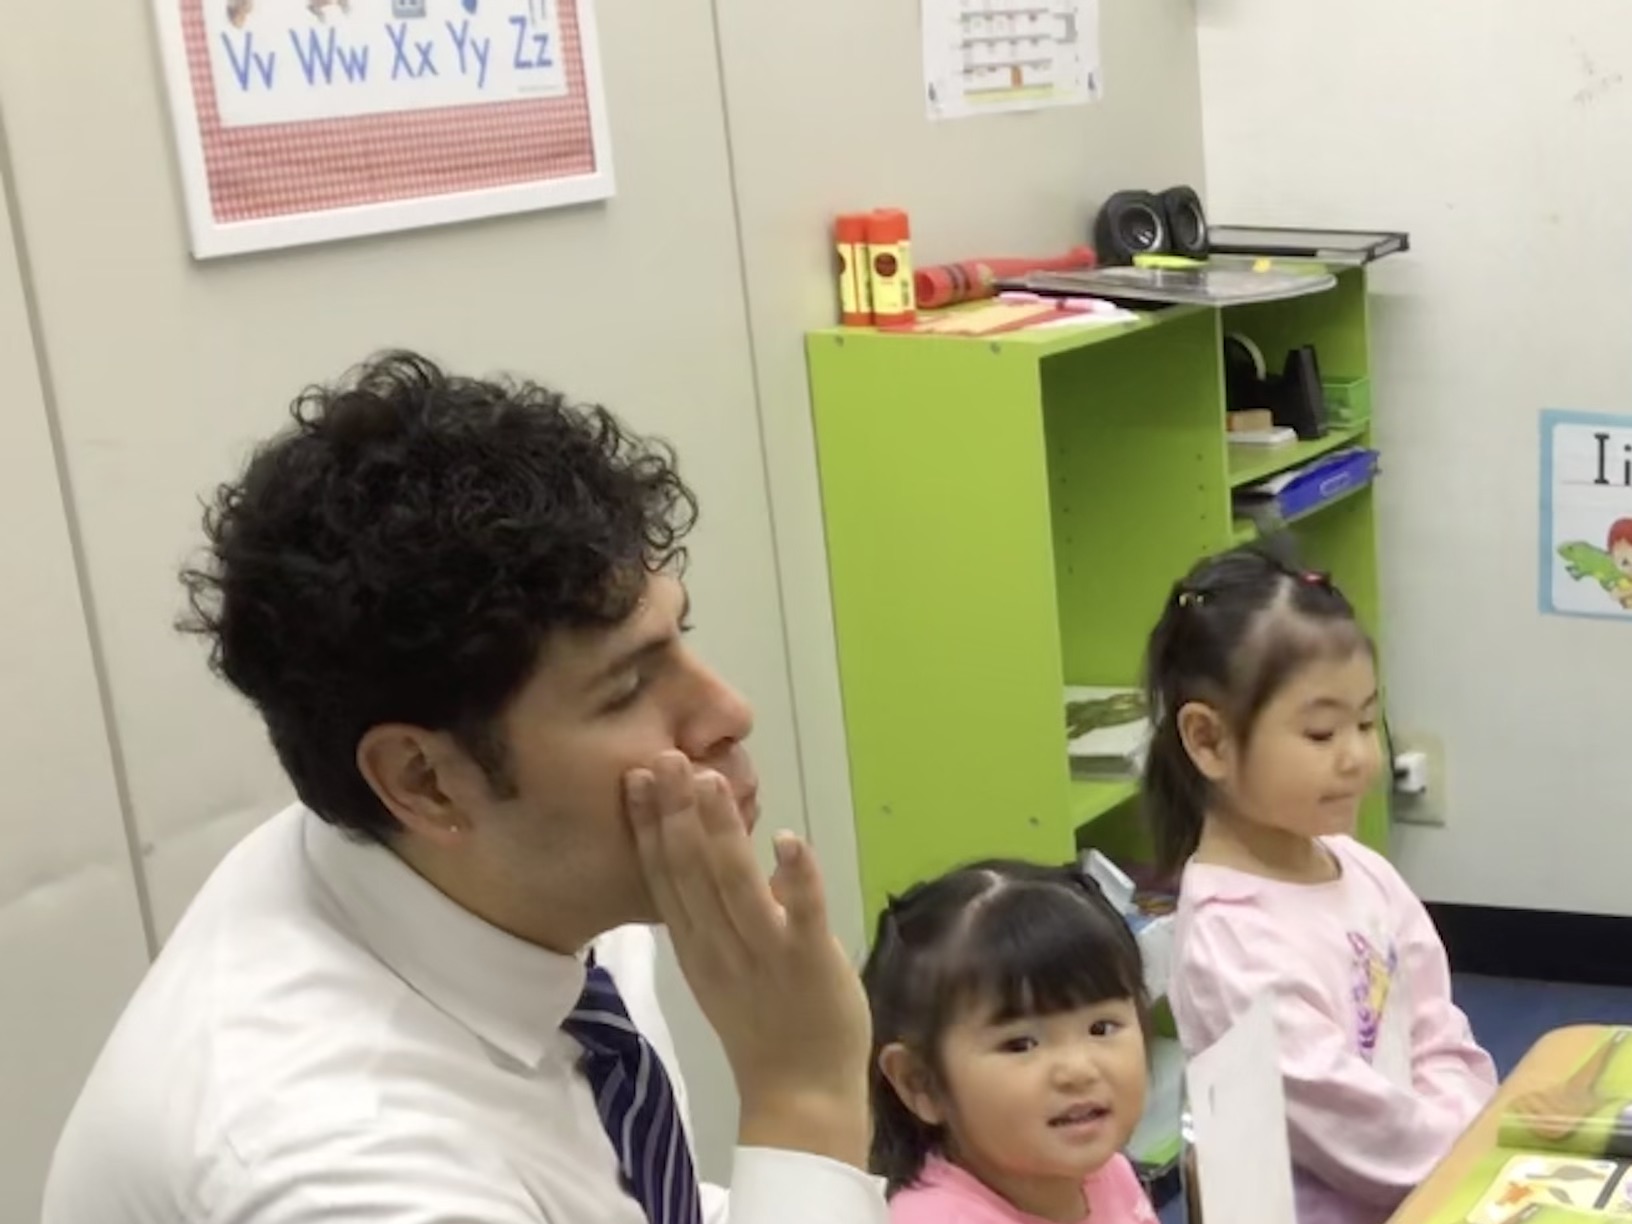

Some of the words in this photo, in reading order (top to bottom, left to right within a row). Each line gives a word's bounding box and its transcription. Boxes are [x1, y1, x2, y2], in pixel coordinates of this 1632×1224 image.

[221, 31, 275, 91] Vv
[288, 26, 368, 86] Ww
[385, 22, 438, 81] Xx
[445, 18, 490, 89] Yy
[509, 15, 553, 69] Zz
[1594, 434, 1632, 486] Ii
